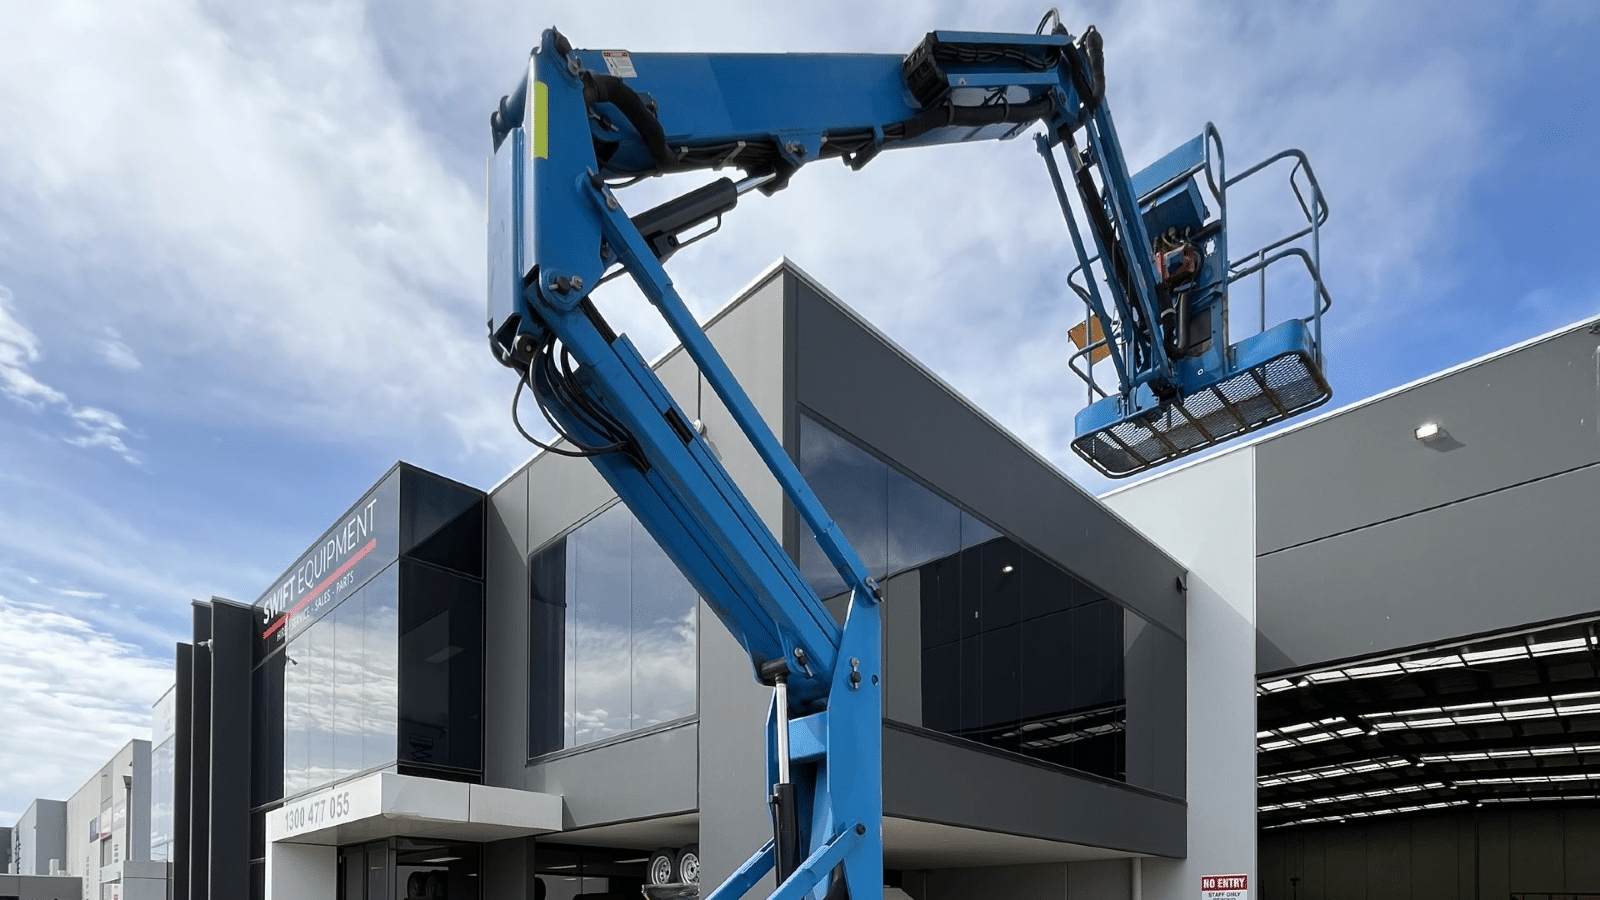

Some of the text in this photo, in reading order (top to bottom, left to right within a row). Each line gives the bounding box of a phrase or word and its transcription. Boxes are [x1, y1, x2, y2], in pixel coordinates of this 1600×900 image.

[263, 498, 377, 625] SWIFT EQUIPMENT
[314, 589, 331, 612] SALES
[336, 570, 354, 595] PARTS
[285, 792, 350, 832] 1300 477 055
[1203, 877, 1245, 888] NO ENTRY
